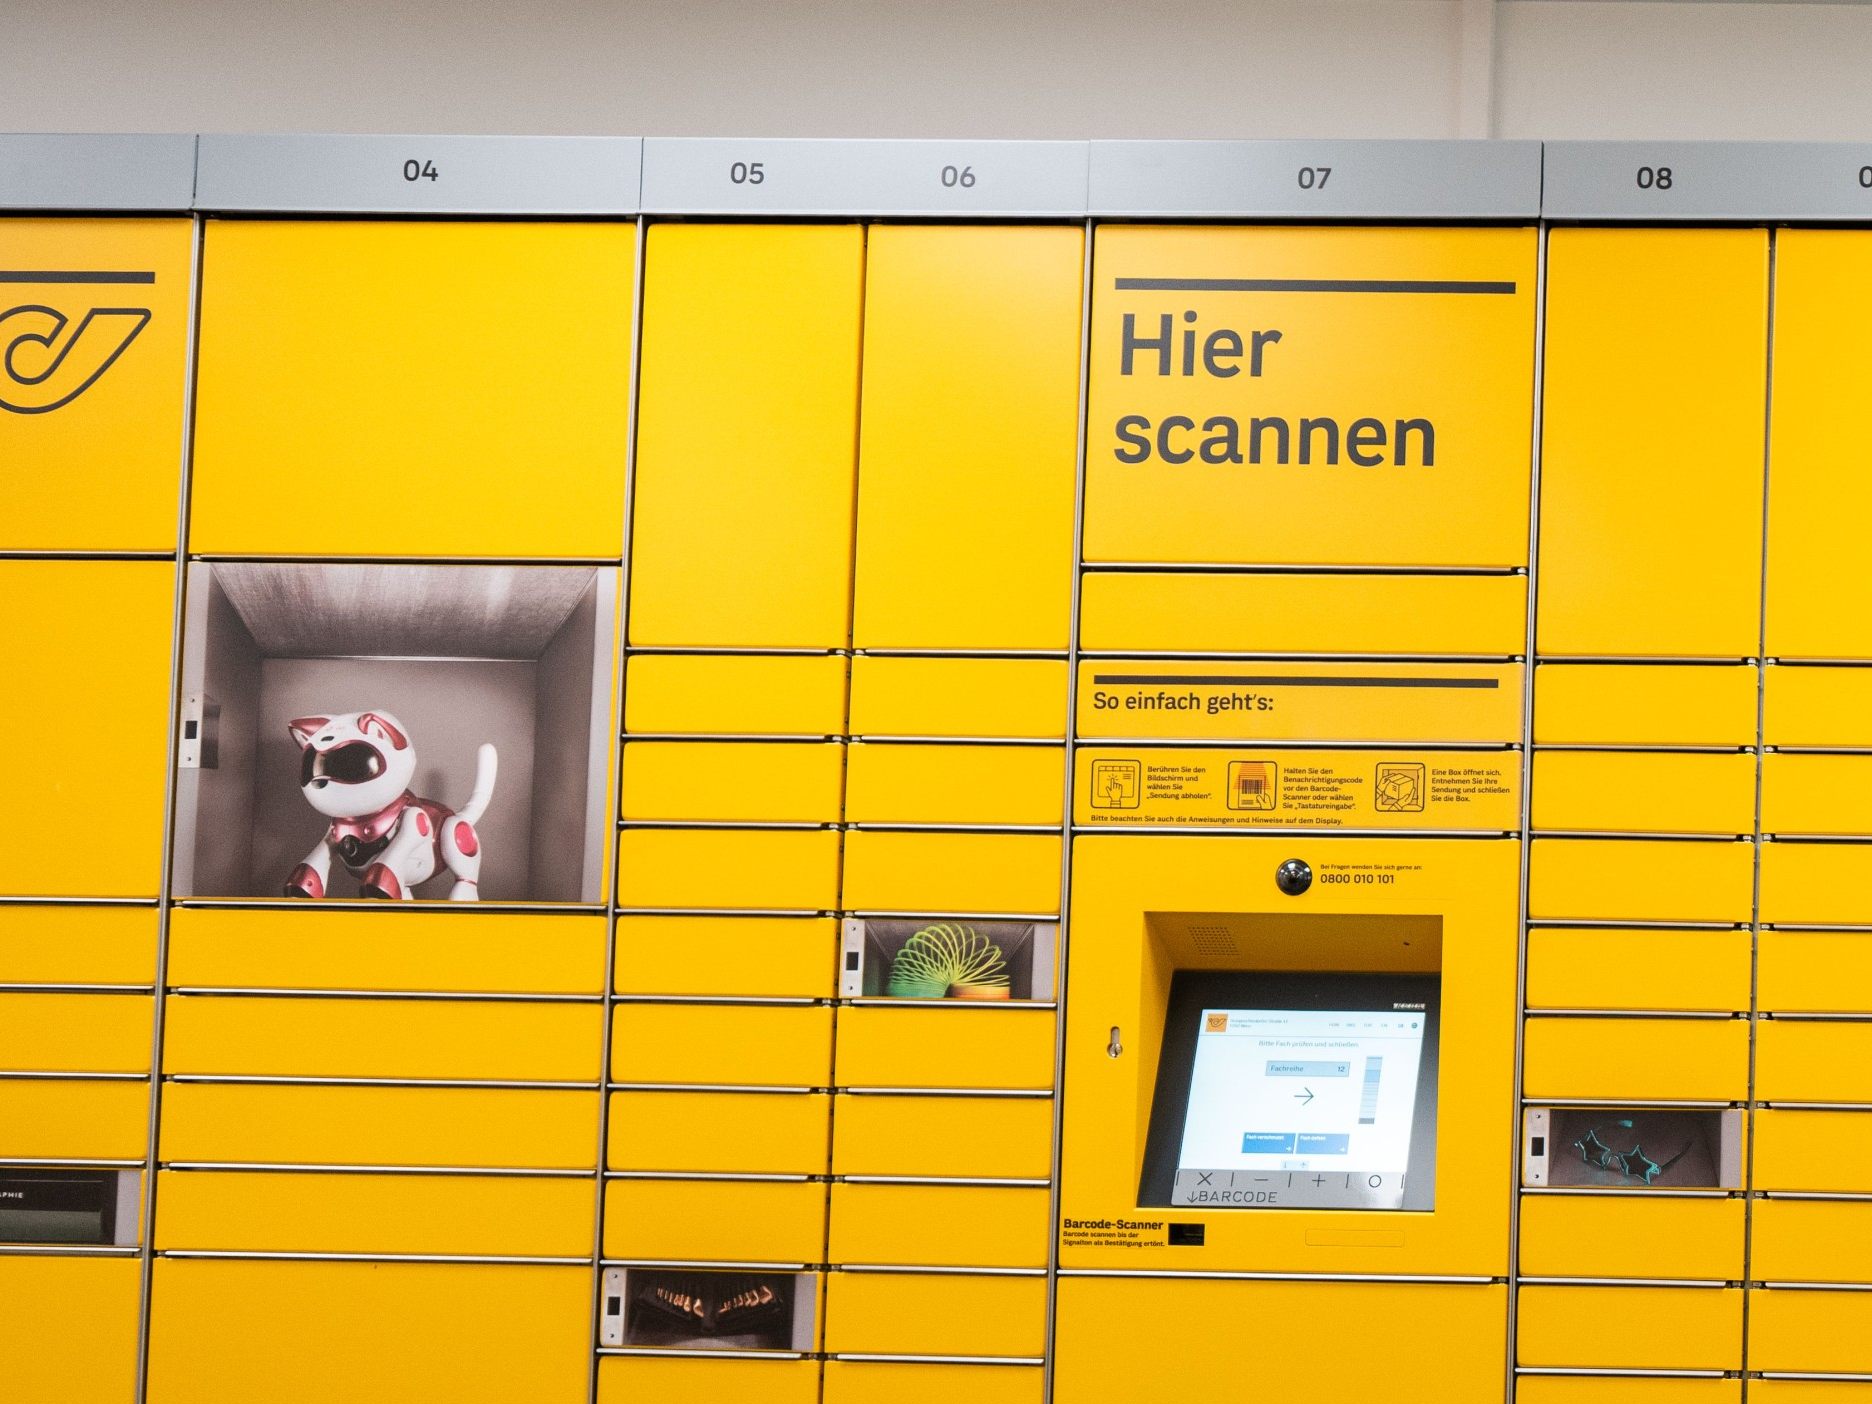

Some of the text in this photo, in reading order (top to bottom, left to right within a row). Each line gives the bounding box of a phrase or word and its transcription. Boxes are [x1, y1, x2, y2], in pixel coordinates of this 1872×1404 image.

[403, 160, 439, 182] 04
[730, 162, 765, 185] 05
[940, 165, 976, 188] 06
[1297, 166, 1332, 190] 07
[1636, 166, 1673, 190] 08
[1120, 310, 1283, 379] Hier
[1114, 415, 1435, 467] scannen
[1094, 691, 1119, 710] So
[1125, 691, 1200, 710] einfach
[1284, 776, 1363, 784] Benachrichtigungscode
[1189, 816, 1234, 824] Anweisungen
[1316, 817, 1343, 825] Display.
[1320, 873, 1394, 884] 0800 010 101
[0, 1191, 24, 1199] PHIE
[1199, 1191, 1278, 1203] BARCODE
[1064, 1219, 1163, 1230] Barcode-Scanner
[1063, 1239, 1092, 1247] Signalton
[1104, 1239, 1142, 1248] Bestätigung
